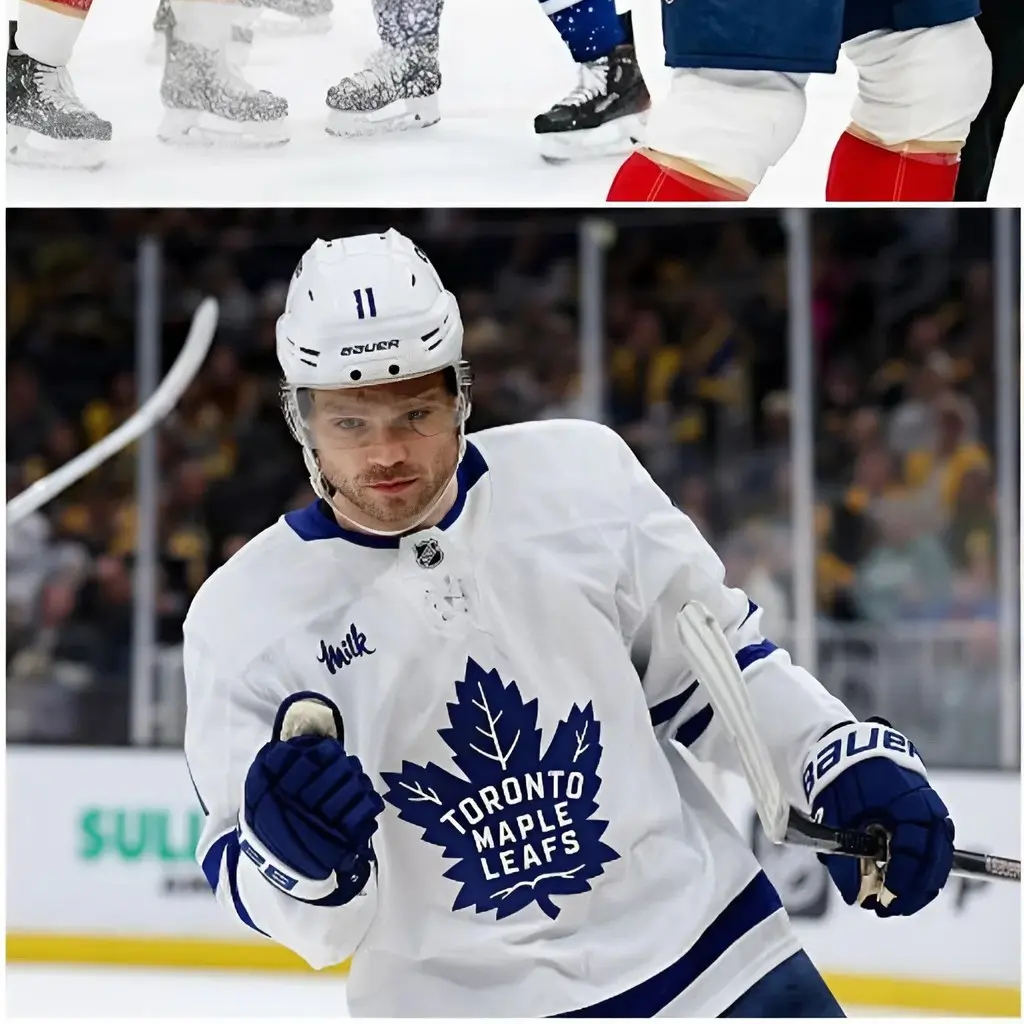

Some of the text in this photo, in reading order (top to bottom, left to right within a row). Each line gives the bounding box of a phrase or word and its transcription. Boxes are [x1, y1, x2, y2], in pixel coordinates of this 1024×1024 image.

[353, 287, 377, 319] 11
[439, 770, 584, 835] TORONTO
[471, 801, 573, 853] MAPLE
[480, 829, 580, 881] LEAFS
